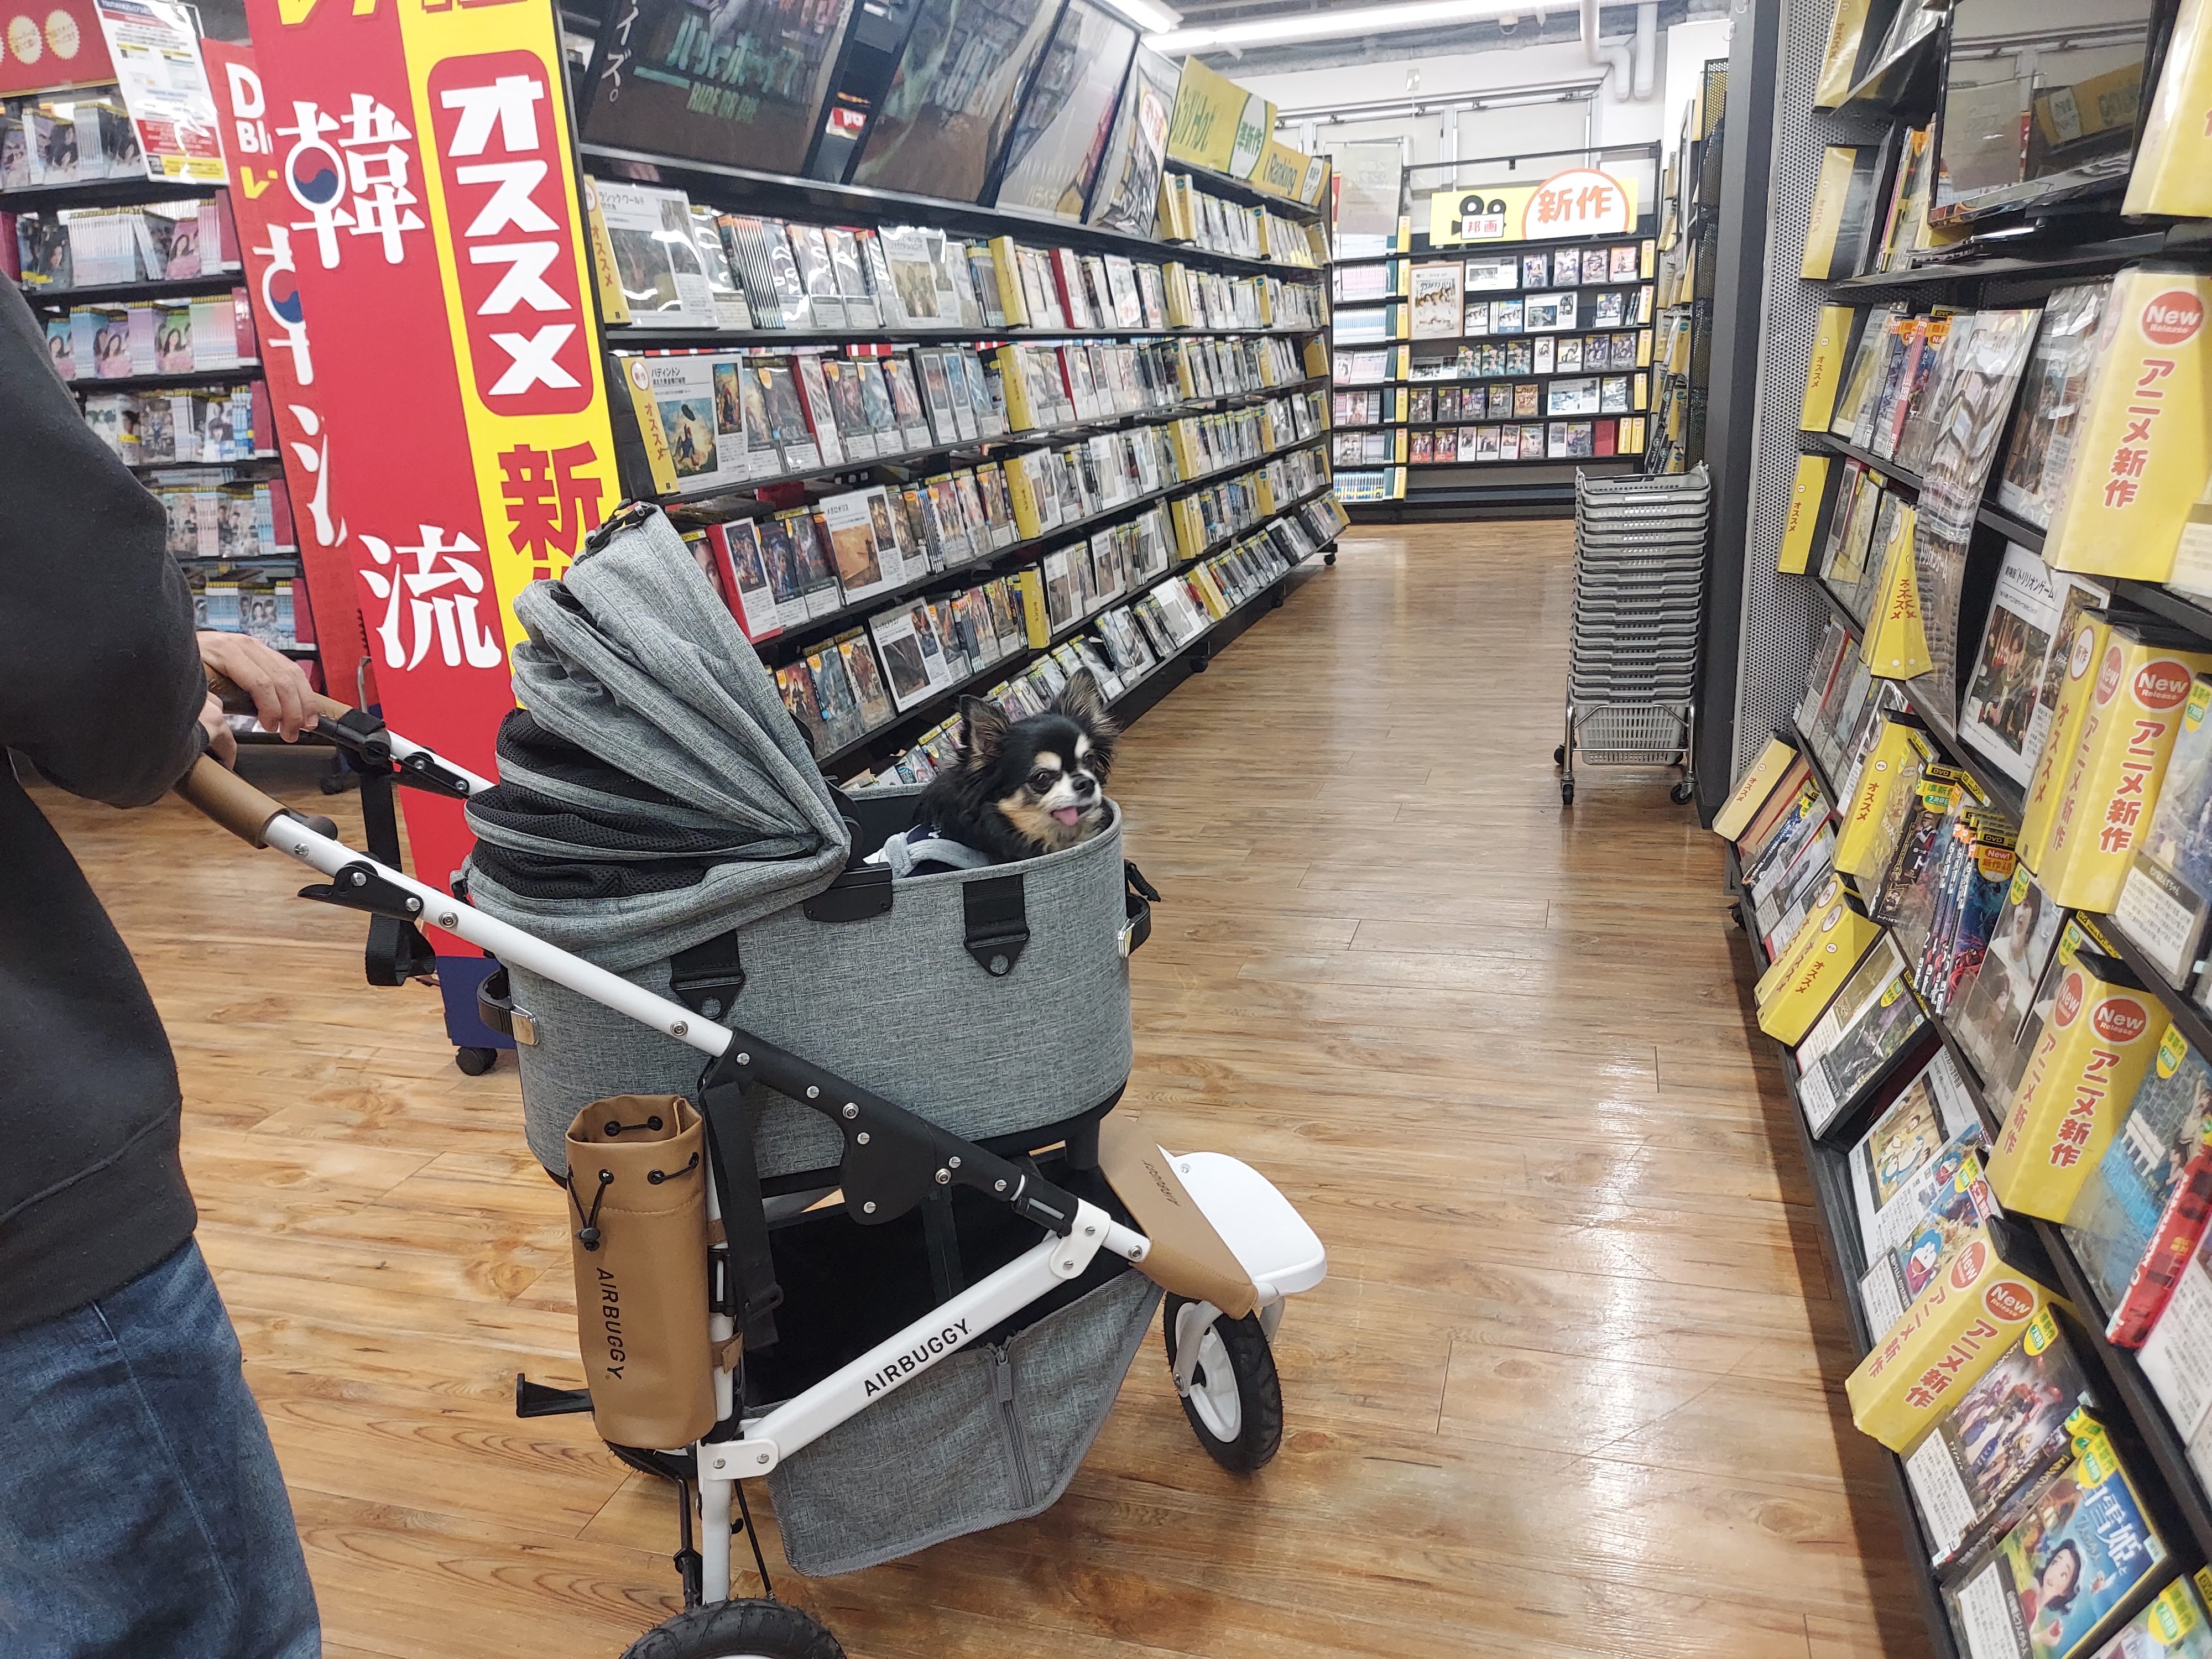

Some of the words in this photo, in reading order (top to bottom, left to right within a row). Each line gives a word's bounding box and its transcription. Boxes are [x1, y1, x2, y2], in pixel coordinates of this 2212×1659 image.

[601, 0, 639, 102] イズ。
[235, 120, 274, 154] Bl
[1185, 93, 1217, 152] Hot
[1269, 153, 1298, 196] Ranking
[1538, 185, 1613, 223] 新作
[441, 74, 582, 396] オススメ
[1467, 219, 1498, 233] 邦画
[592, 225, 613, 287] オススメ
[2146, 305, 2200, 327] New
[2150, 323, 2188, 335] Release
[275, 92, 502, 672] 韓流
[651, 367, 681, 378] パディントン
[1810, 354, 1826, 389] オススメ
[644, 403, 664, 461] オススメ
[2104, 358, 2176, 508] アニメ新作
[497, 441, 604, 581] 新
[1788, 500, 1802, 533] オススメ
[2137, 672, 2189, 695] New
[2141, 688, 2179, 702] Release
[1933, 768, 1950, 776] DVD
[2034, 702, 2070, 804] オススメ
[1736, 777, 1757, 802] オススメ
[1856, 781, 1880, 821] オススメ
[2053, 715, 2099, 852] アニメ新作
[2100, 719, 2166, 853] アニメ新作
[1985, 835, 2003, 844] DVD
[1987, 850, 2011, 860] New!
[1774, 916, 1812, 968] オススメ
[1776, 941, 1815, 993] オススメ
[1795, 961, 1825, 994] オススメ
[2059, 982, 2078, 1013] New
[2097, 1006, 2145, 1031] New
[2100, 1021, 2133, 1036] Release
[2004, 1032, 2057, 1155] アニメ新作
[2049, 1049, 2121, 1167] アニメ新作
[1960, 1246, 1978, 1281] New
[1990, 1285, 2031, 1314] New
[1990, 1298, 2018, 1318] Release
[596, 1267, 626, 1381] AIRBUGGY
[1867, 1285, 1947, 1378] アニメ新作
[864, 1318, 969, 1397] AIRBUGGY
[1905, 1318, 1998, 1408] アニメ新作
